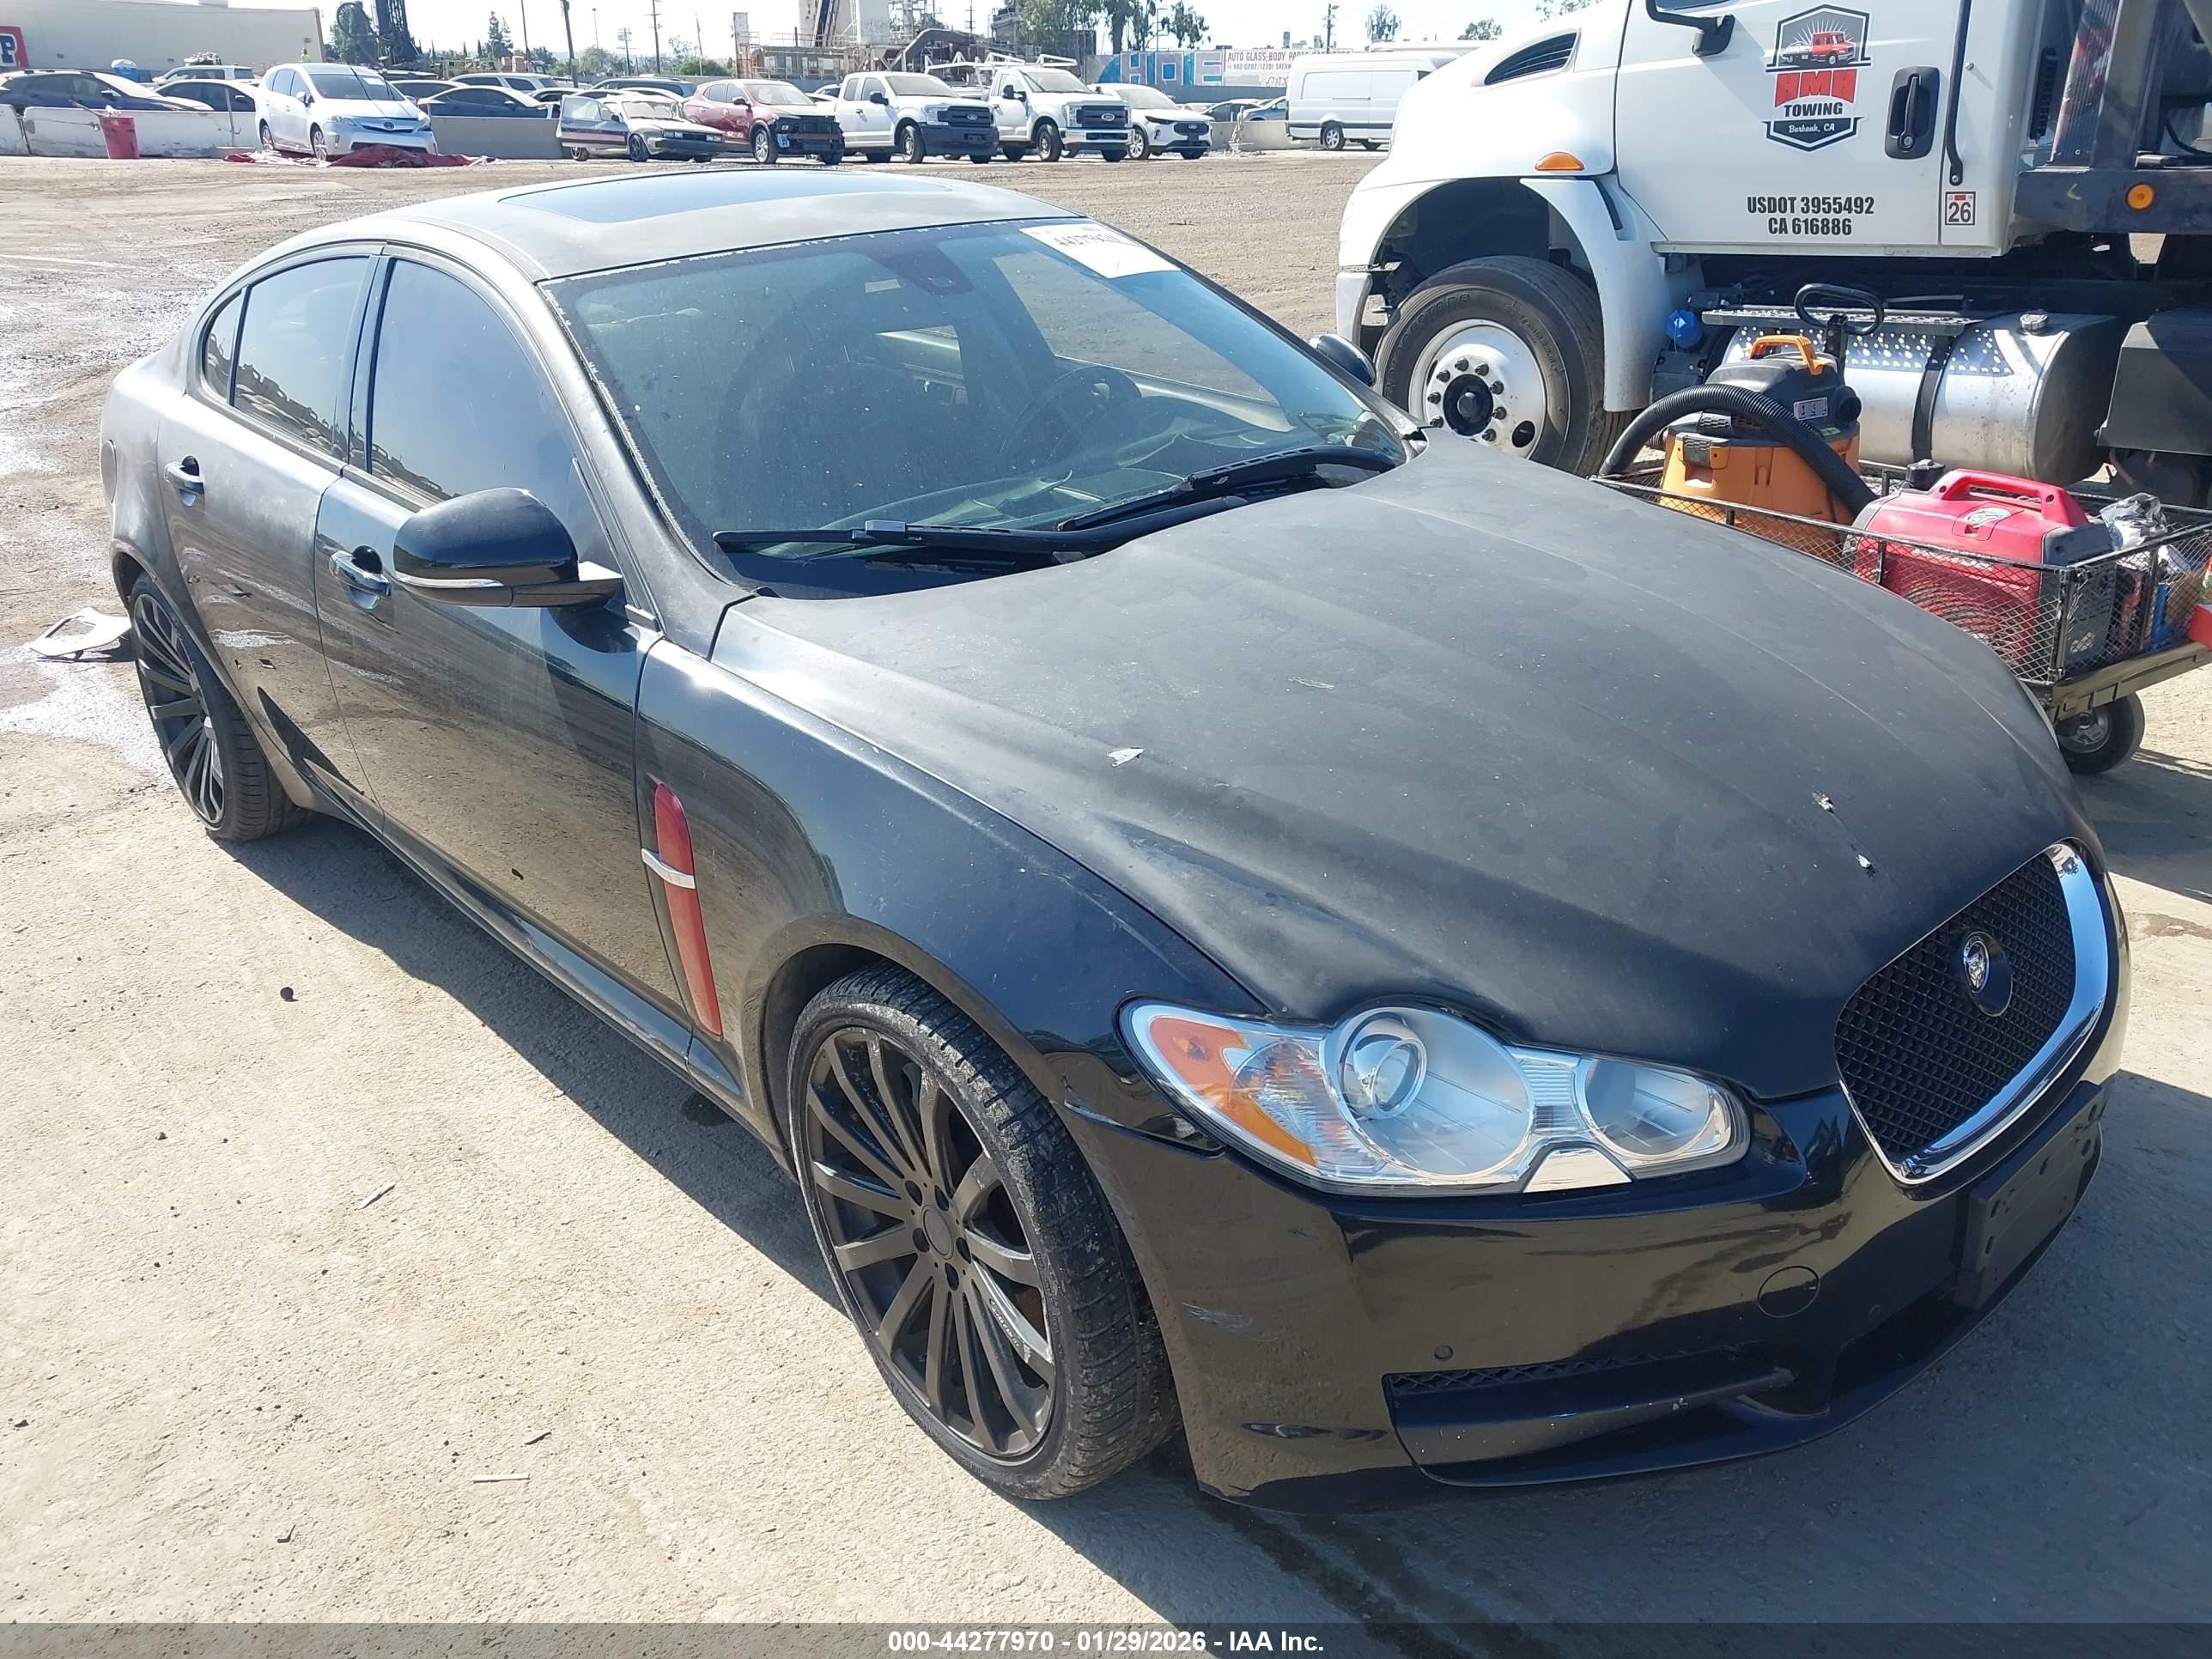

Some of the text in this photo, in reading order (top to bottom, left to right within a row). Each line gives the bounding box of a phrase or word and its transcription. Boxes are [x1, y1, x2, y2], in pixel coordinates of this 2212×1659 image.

[1228, 52, 1244, 62] AUTO
[1774, 69, 1858, 108] HMH
[1784, 101, 1844, 118] TOWING
[1788, 123, 1835, 133] Burbank, CA
[1747, 196, 1874, 214] USDOT 3955492
[1948, 202, 1972, 222] 26
[1768, 217, 1851, 235] CA 616886
